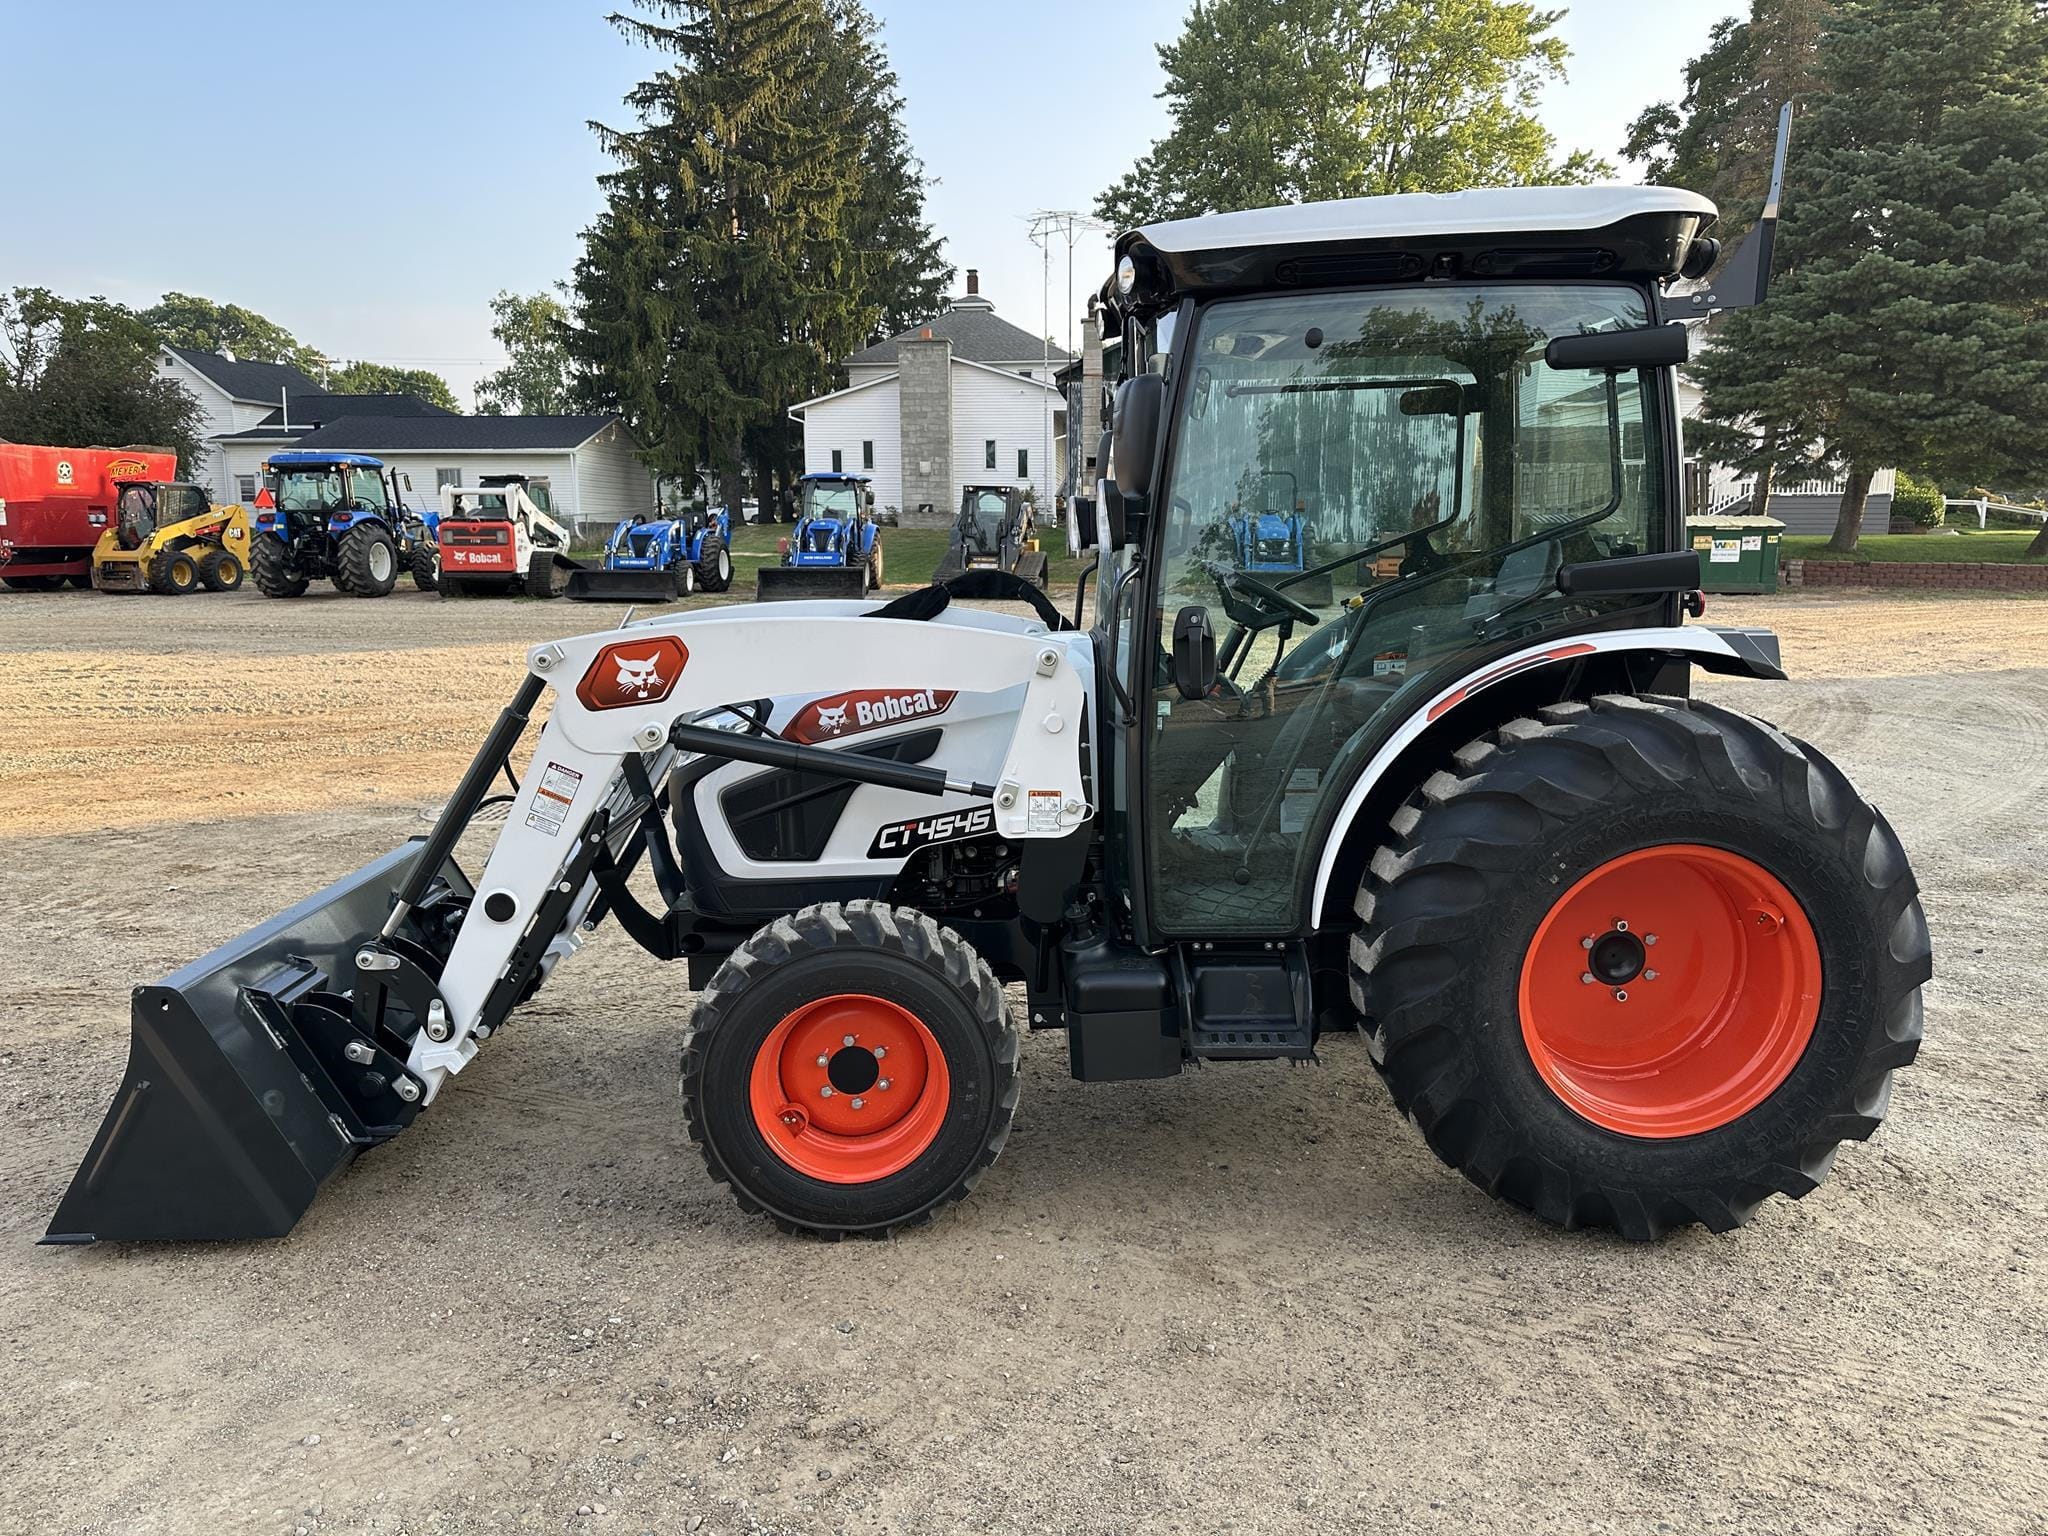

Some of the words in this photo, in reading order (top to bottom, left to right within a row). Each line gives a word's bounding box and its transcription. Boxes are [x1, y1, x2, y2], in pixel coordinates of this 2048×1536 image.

[111, 465, 139, 478] MEYER
[228, 528, 241, 538] CAT
[469, 552, 502, 564] Bobcat
[855, 689, 938, 726] Bobcat
[556, 765, 581, 779] DANGER
[878, 808, 992, 849] CT4545
